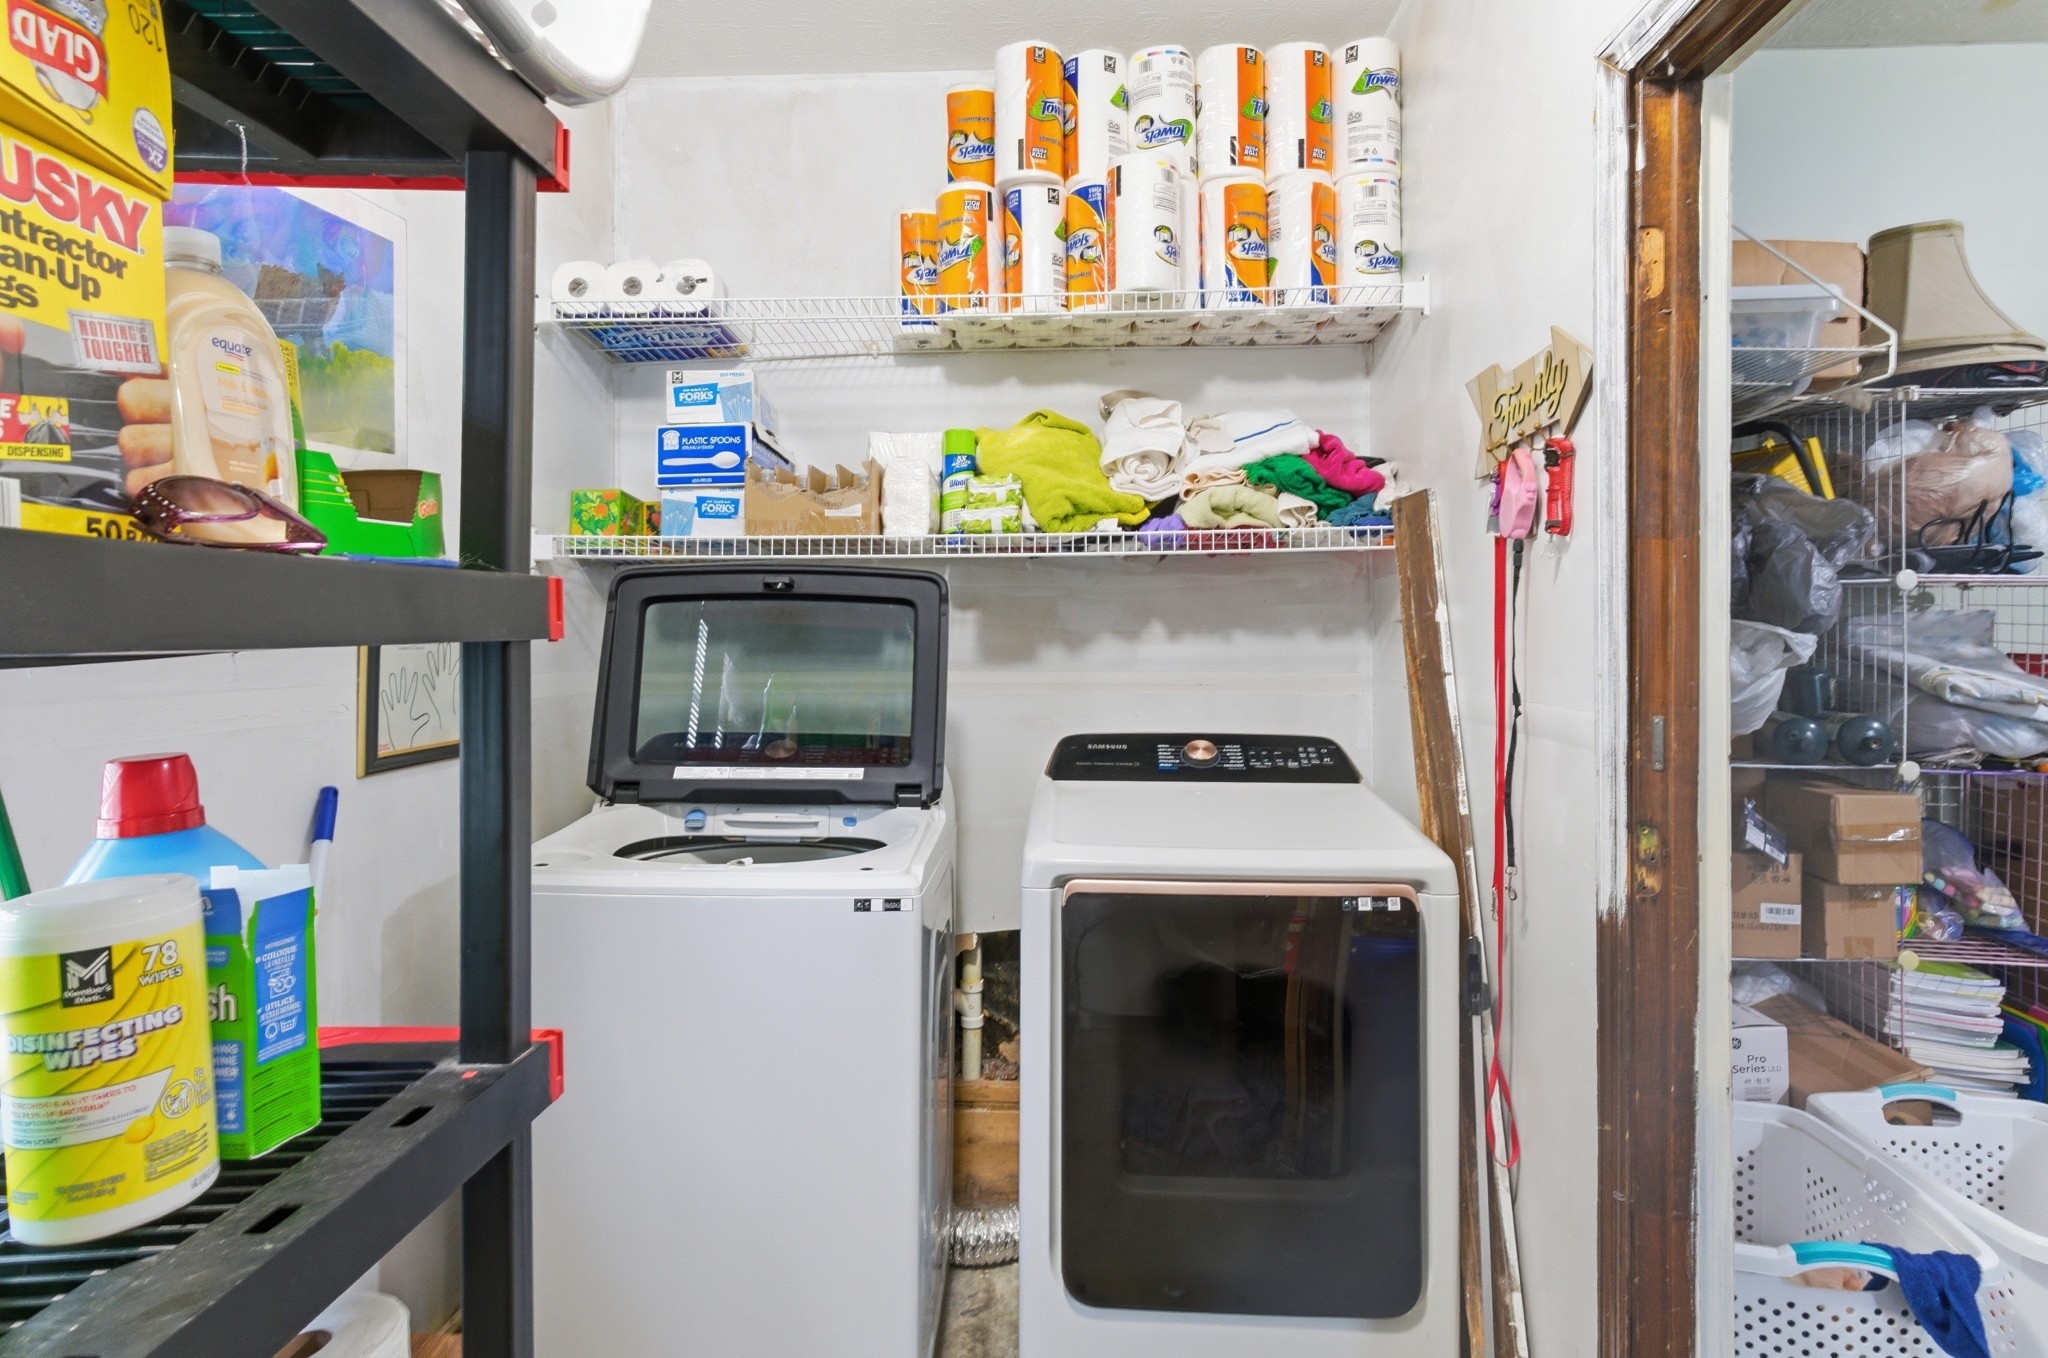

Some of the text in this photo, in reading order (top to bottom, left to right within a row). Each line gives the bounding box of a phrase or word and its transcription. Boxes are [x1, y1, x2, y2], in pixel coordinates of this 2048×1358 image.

[12, 8, 100, 82] GLAD
[1143, 124, 1187, 144] Towels
[957, 143, 995, 159] owels
[0, 143, 149, 252] USKY
[0, 208, 129, 280] ntractor
[1241, 241, 1267, 256] wels
[0, 244, 102, 302] an-Up
[1366, 255, 1399, 268] wels
[0, 274, 39, 309] gs
[78, 319, 148, 343] NOTHING'S
[81, 338, 153, 364] TOUGHER
[212, 337, 252, 356] equate
[679, 390, 713, 402] FORKS
[1489, 350, 1568, 438] Family
[7, 445, 64, 459] DISPENSING
[682, 436, 741, 445] PLASTIC SPOONS
[949, 478, 968, 488] Wool
[701, 503, 735, 513] FORKS
[87, 517, 121, 540] 50
[142, 940, 178, 972] 78
[138, 964, 183, 987] WIPES
[8, 1004, 183, 1056] DISINFECTING
[43, 1038, 139, 1073] WIPES
[1747, 1054, 1767, 1063] Pro
[1732, 1064, 1766, 1074] Series
